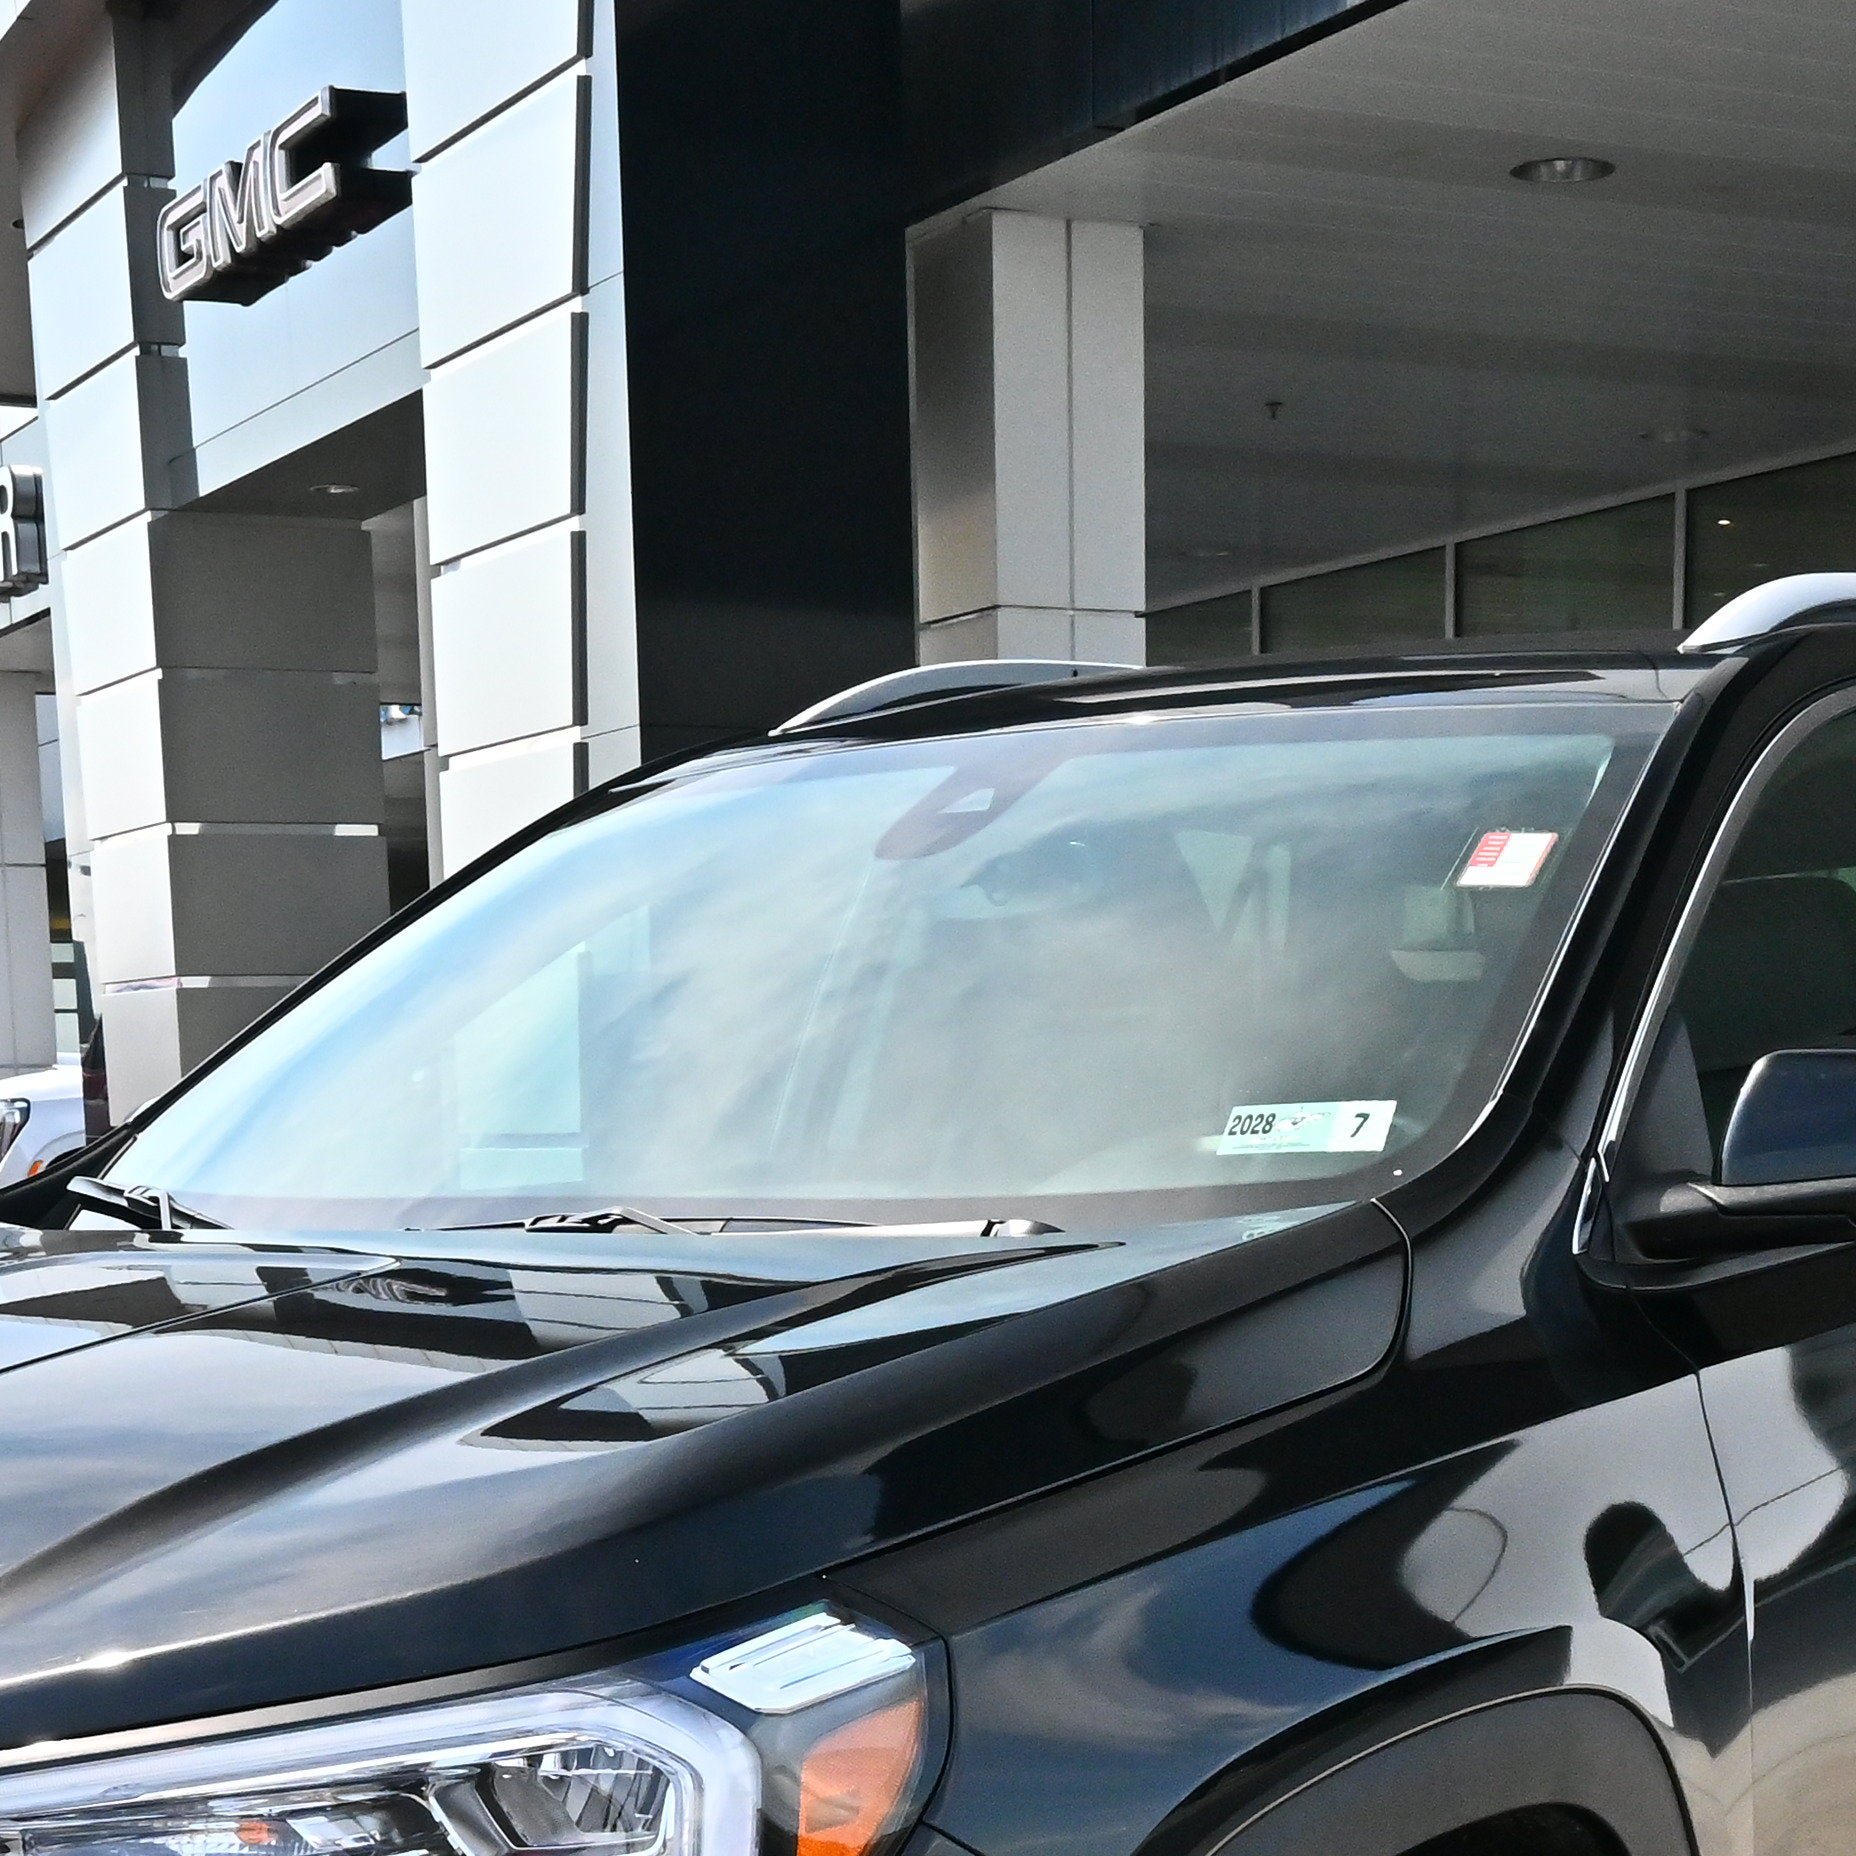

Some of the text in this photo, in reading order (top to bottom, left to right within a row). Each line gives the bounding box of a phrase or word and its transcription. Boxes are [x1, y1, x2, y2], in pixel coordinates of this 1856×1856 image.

[157, 85, 346, 303] GMC
[1227, 1112, 1371, 1138] 2028 7
